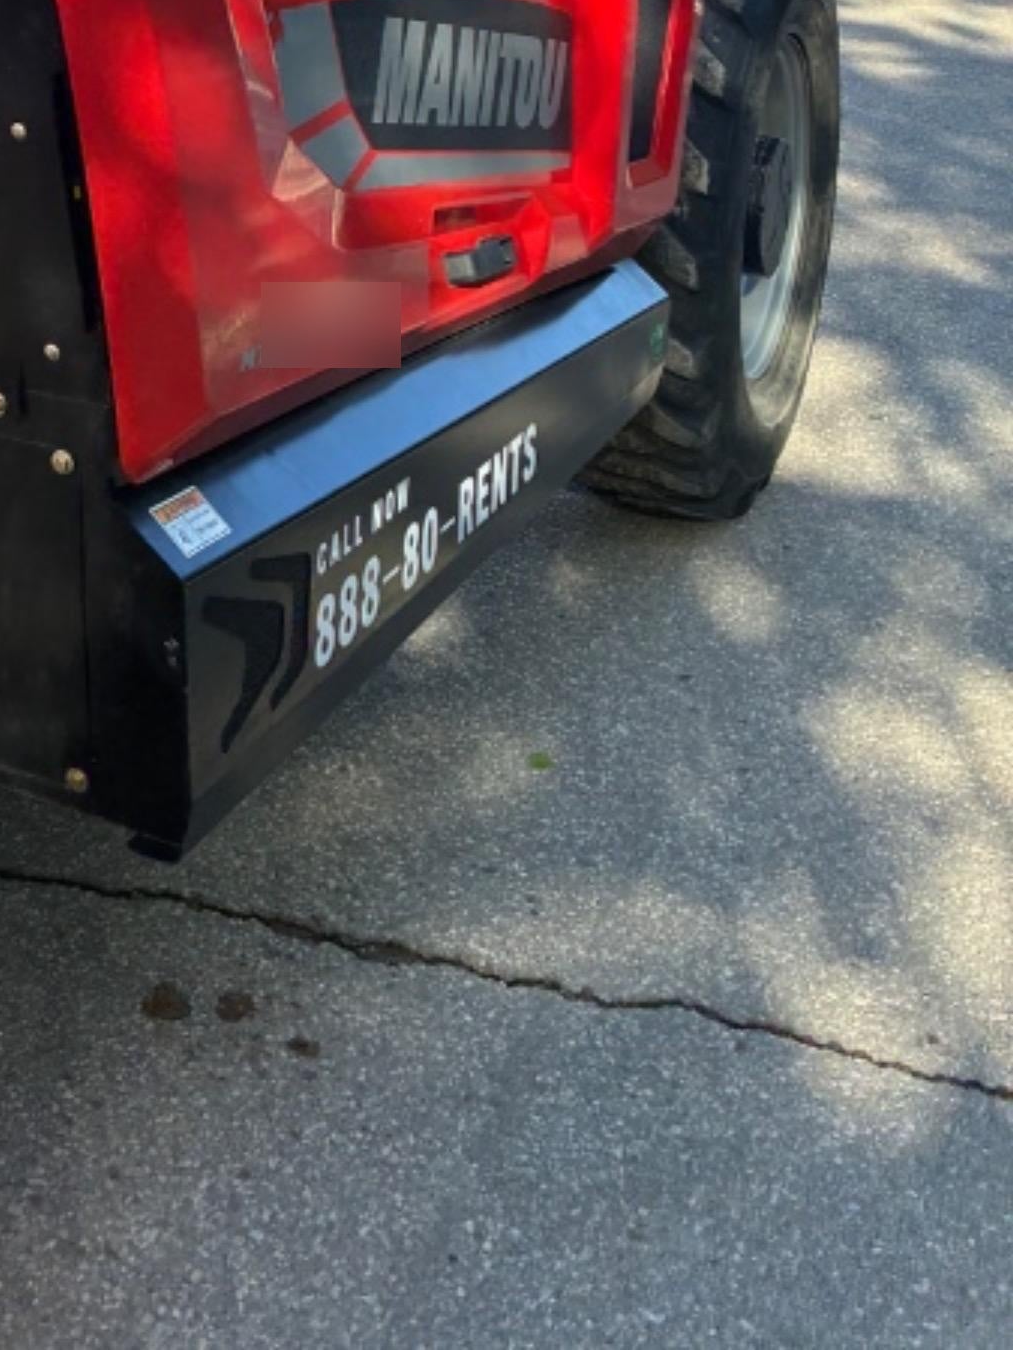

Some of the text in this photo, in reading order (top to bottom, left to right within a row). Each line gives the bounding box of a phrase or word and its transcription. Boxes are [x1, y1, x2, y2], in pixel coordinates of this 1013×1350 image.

[372, 17, 568, 129] MANITOU
[314, 423, 539, 668] 888-80-RENTS
[316, 477, 412, 575] CALL NOW
